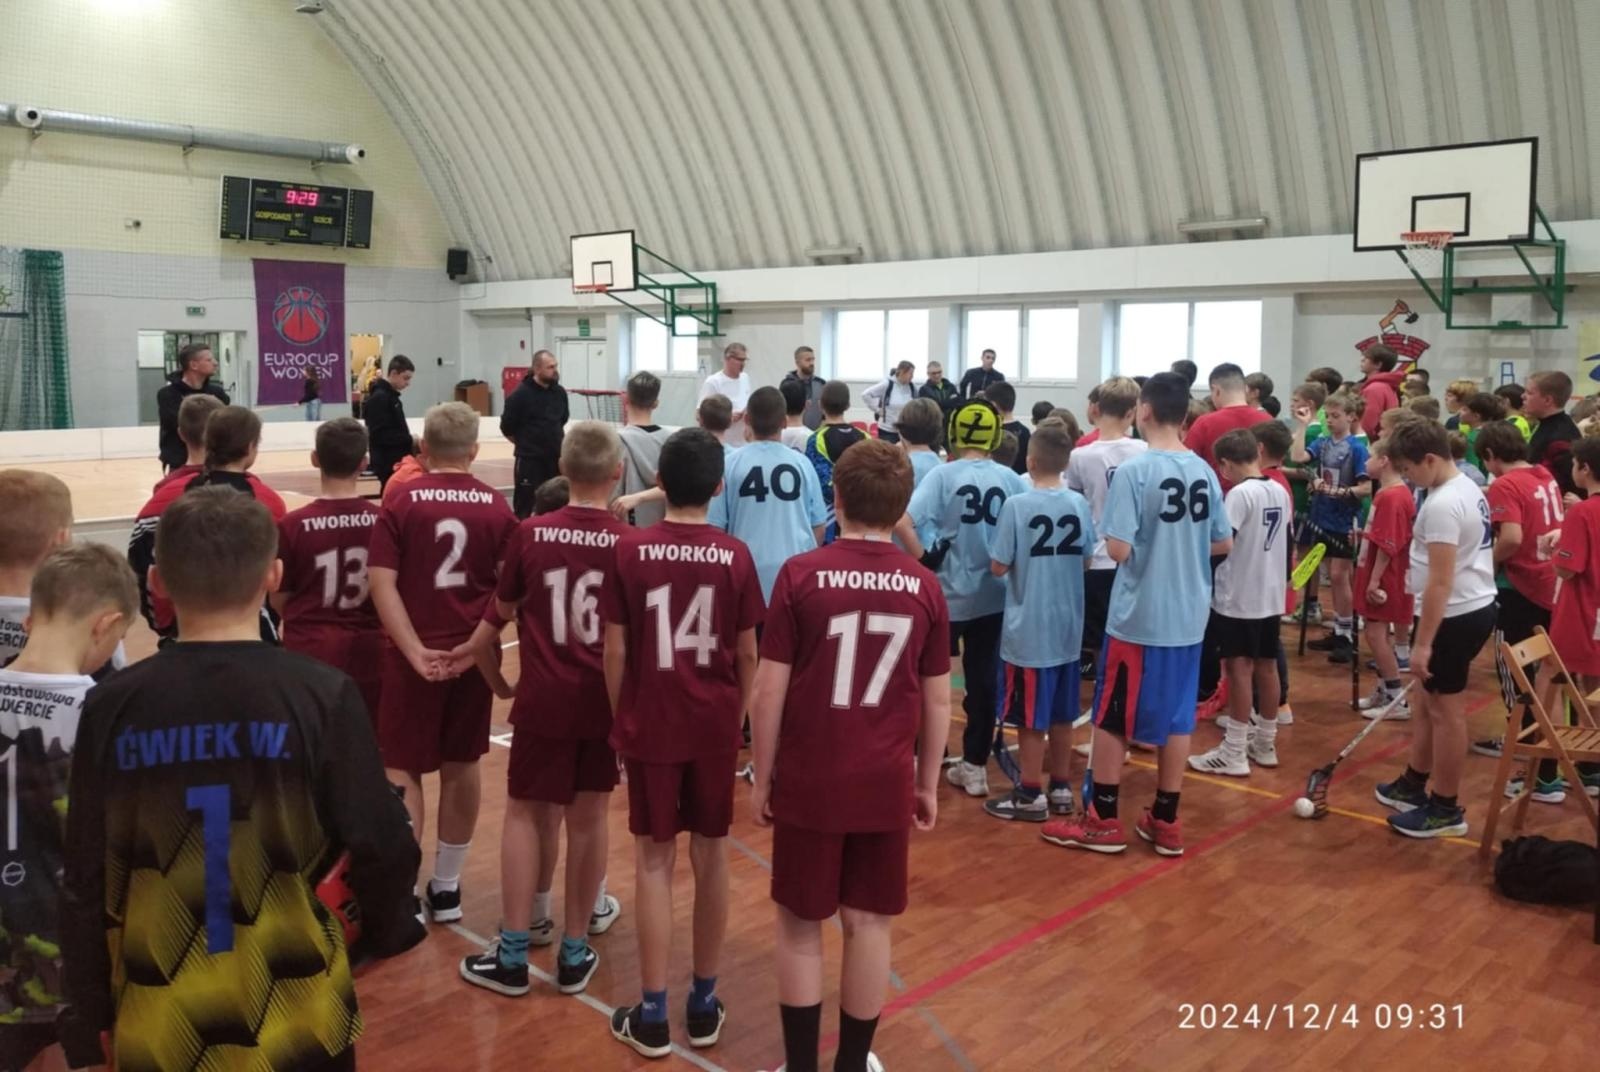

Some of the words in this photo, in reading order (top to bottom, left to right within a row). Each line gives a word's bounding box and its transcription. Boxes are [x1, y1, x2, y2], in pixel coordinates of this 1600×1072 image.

[285, 190, 319, 206] 9:29
[264, 353, 339, 366] EUROCUP
[409, 488, 493, 504] TWORKÓW
[738, 463, 801, 502] 40
[1159, 477, 1209, 523] 36
[956, 484, 1006, 526] 30
[1029, 514, 1084, 557] 22
[1263, 507, 1282, 551] 7
[434, 517, 468, 589] 2
[638, 542, 734, 566] TWORKÓW
[315, 547, 369, 610] 13
[816, 569, 921, 594] TWORKÓW
[543, 566, 604, 646] 16
[645, 582, 719, 671] 14
[826, 610, 914, 709] 17
[115, 722, 241, 771] ĆWIEK
[250, 721, 292, 759] W.
[185, 784, 235, 955] 1
